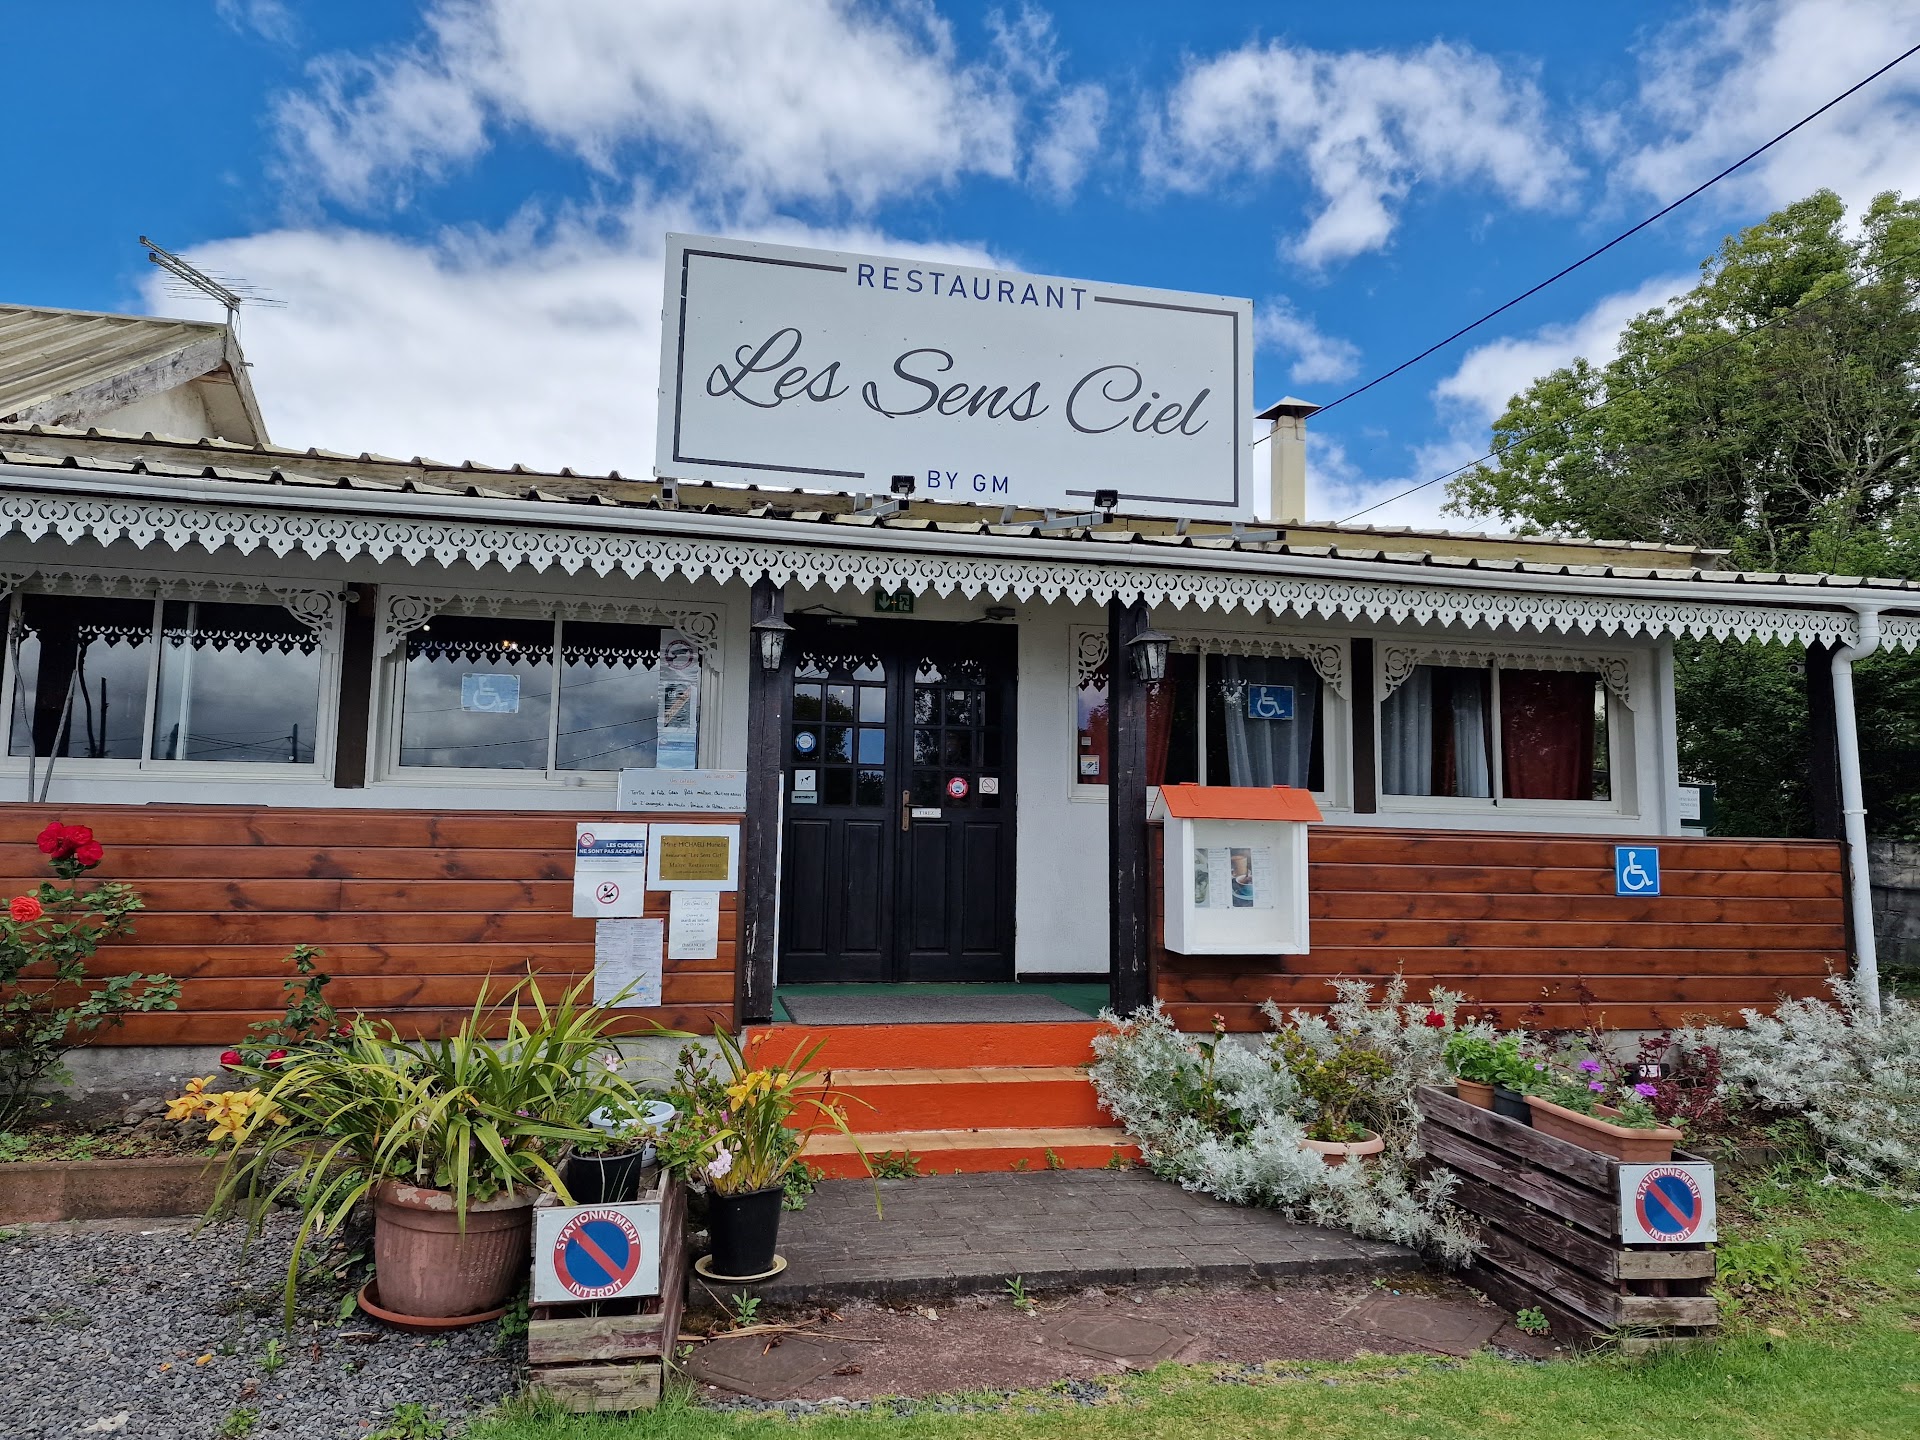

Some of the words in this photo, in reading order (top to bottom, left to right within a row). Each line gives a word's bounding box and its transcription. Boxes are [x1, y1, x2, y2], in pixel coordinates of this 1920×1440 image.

[858, 263, 1087, 311] RESTAURANT
[706, 327, 849, 409] Les
[862, 348, 1050, 422] Sens
[1065, 364, 1212, 437] Ciel
[927, 470, 959, 488] BY
[973, 474, 1009, 494] GM
[1637, 1168, 1700, 1201] STATIONNEMENT
[556, 1210, 639, 1250] STATIONNEMENT
[1649, 1227, 1692, 1242] INTERDIT
[568, 1278, 623, 1299] INTERDIT
